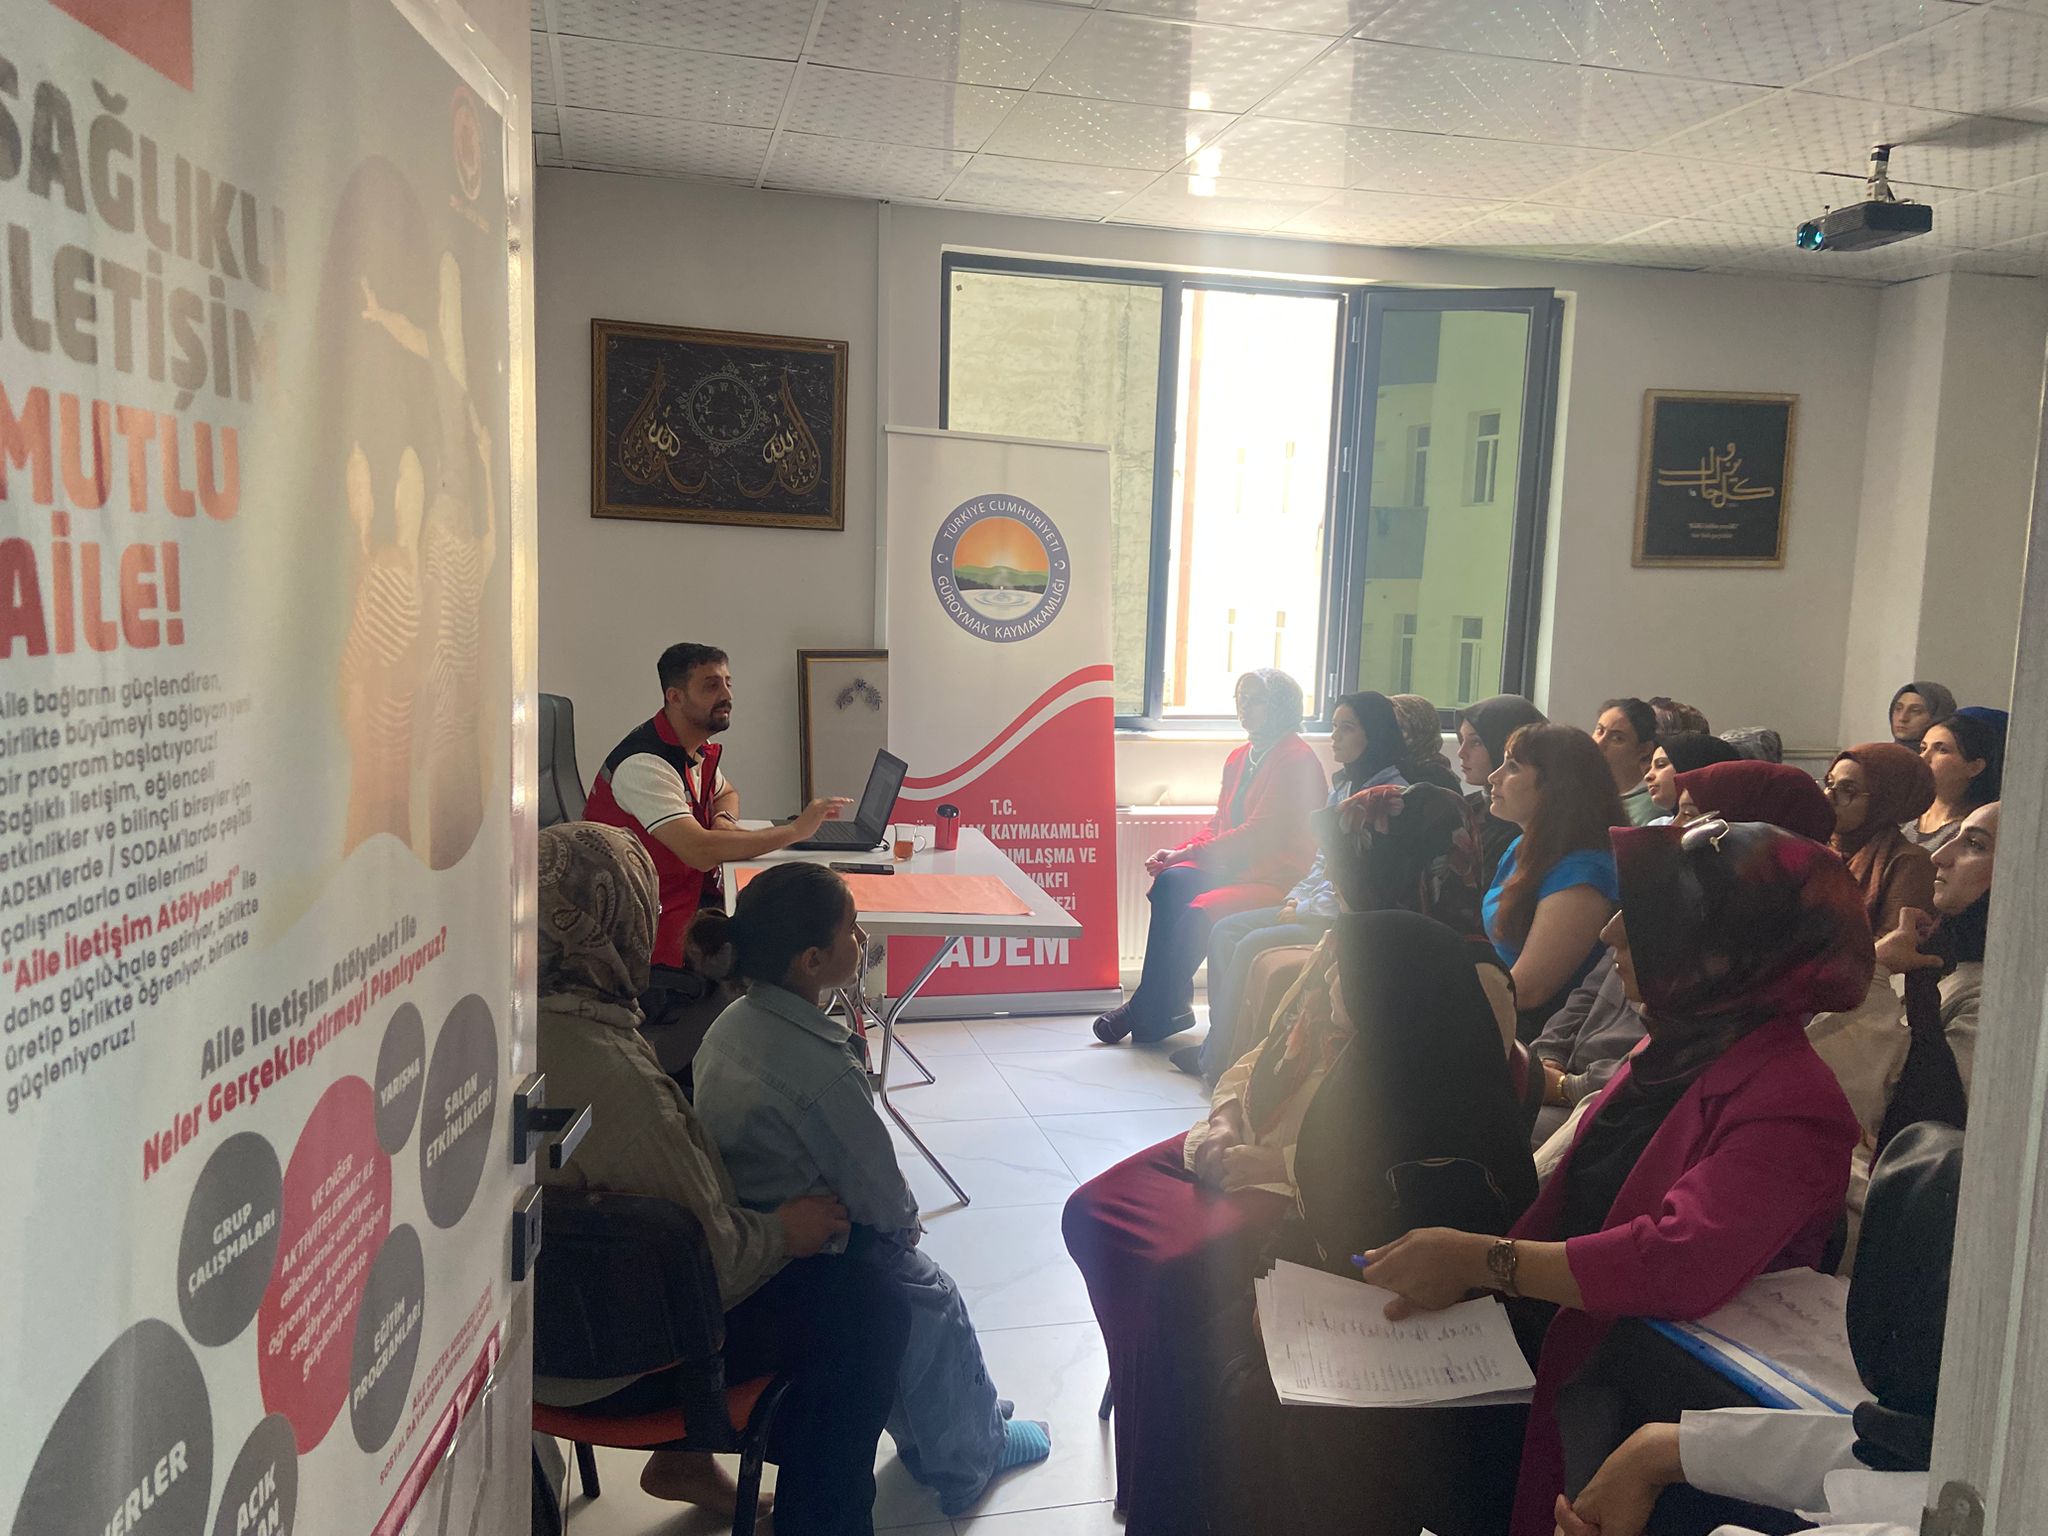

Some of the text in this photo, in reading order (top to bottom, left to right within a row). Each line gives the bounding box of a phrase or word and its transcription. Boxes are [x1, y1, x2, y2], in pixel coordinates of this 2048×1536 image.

[0, 378, 241, 522] MUTLU
[943, 499, 1063, 553] TÜRKİYE CUMHURİYETİ
[0, 511, 185, 660] AİLE!
[937, 575, 1066, 639] GÜROYMAK KAYMAKAMLIĞI
[0, 673, 222, 721] ile bağlarını güçlendiren,
[66, 708, 153, 747] büyümeyi
[158, 700, 226, 732] sağlayan
[0, 760, 215, 836] Sağlıklı iletişim, eğlenceli
[28, 755, 108, 797] program
[113, 730, 218, 772] başlatıyoruz!
[0, 828, 89, 873] etkinlikler
[94, 820, 116, 842] ve
[121, 804, 179, 831] bilinçli
[183, 790, 229, 819] bireyler
[990, 799, 1017, 815] T.C.
[991, 819, 1099, 840] KAYMAKAMLIĞI
[1079, 847, 1097, 863] VE
[1, 851, 208, 956] çalışmalarla ailelerimizi
[65, 914, 152, 970] İletişim
[242, 870, 257, 891] ile
[4, 897, 259, 1034] daha güçlü hale getiriyor, birlikte
[940, 936, 1069, 968] ADEM
[5, 930, 249, 1071] üretip birlikte öğreniyor, birlikte
[201, 914, 417, 1080] Aile İletişim Atölyeleri ile
[7, 1020, 135, 1114] güçleniyoruz!
[143, 925, 447, 1181] Neler Gerçekleştirmeyi Planlıyoruz?
[380, 1057, 420, 1108] YARIŞMA
[426, 1079, 493, 1168] ETKİNLİKLERİ
[445, 1072, 478, 1120] SALON
[311, 1153, 353, 1212] VE DİĞER
[188, 1208, 275, 1298] ÇALIŞMALARI
[213, 1203, 252, 1245] GRUP
[374, 1296, 405, 1354] EĞİTİM
[237, 1461, 276, 1536] AÇIK
